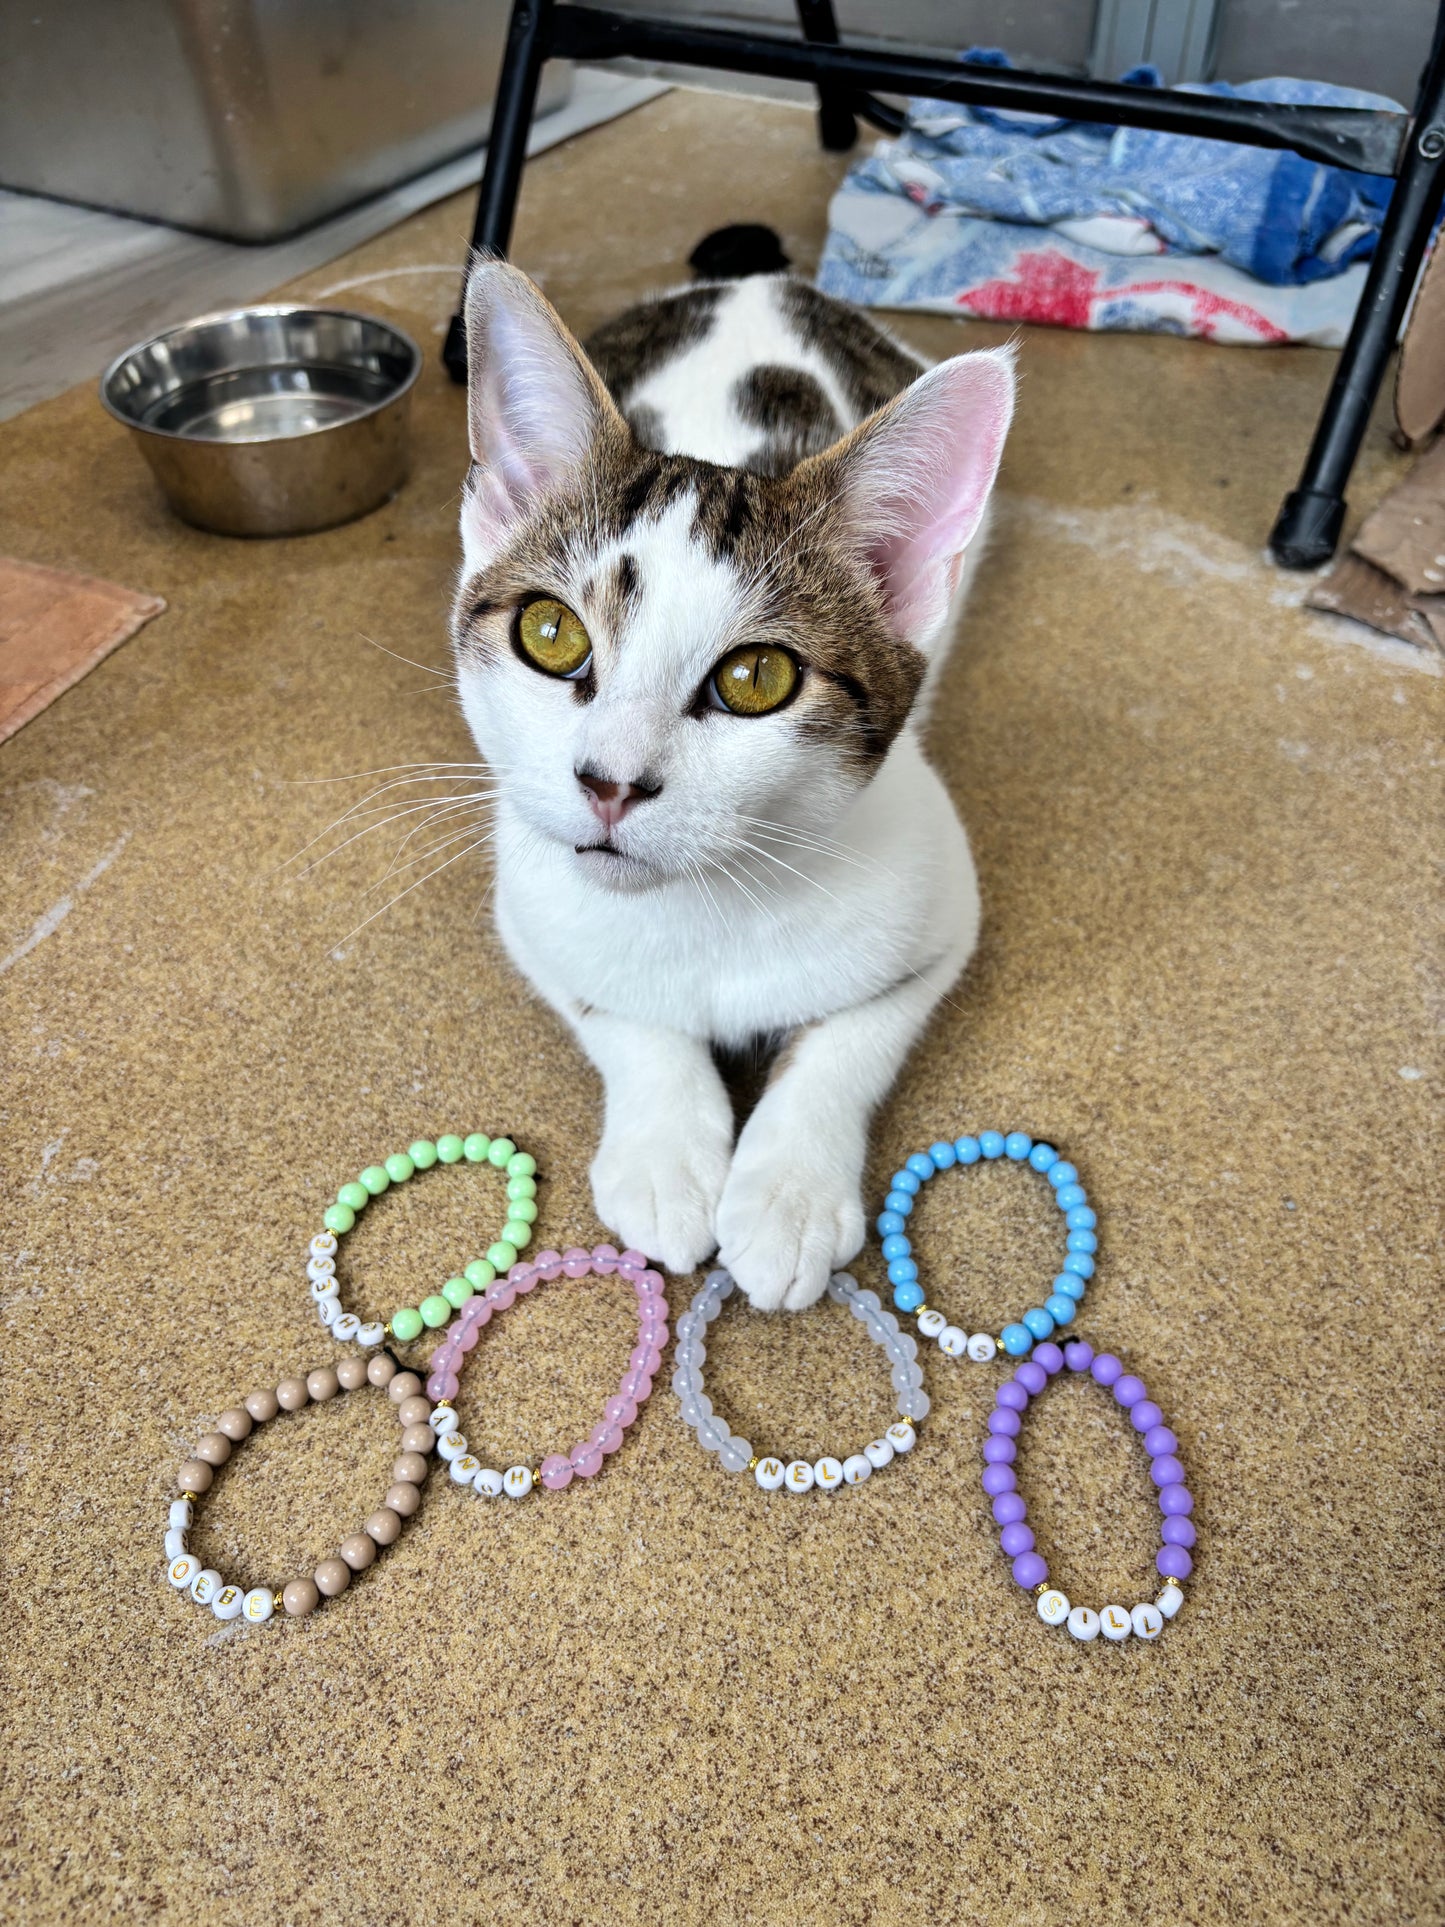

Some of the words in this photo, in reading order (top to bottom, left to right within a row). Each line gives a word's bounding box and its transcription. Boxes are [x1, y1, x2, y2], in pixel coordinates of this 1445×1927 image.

[313, 1237, 376, 1332] CHEESE
[433, 1415, 524, 1494] HONEY
[173, 1507, 263, 1617] OEBE
[1043, 1592, 1162, 1635] SILL
